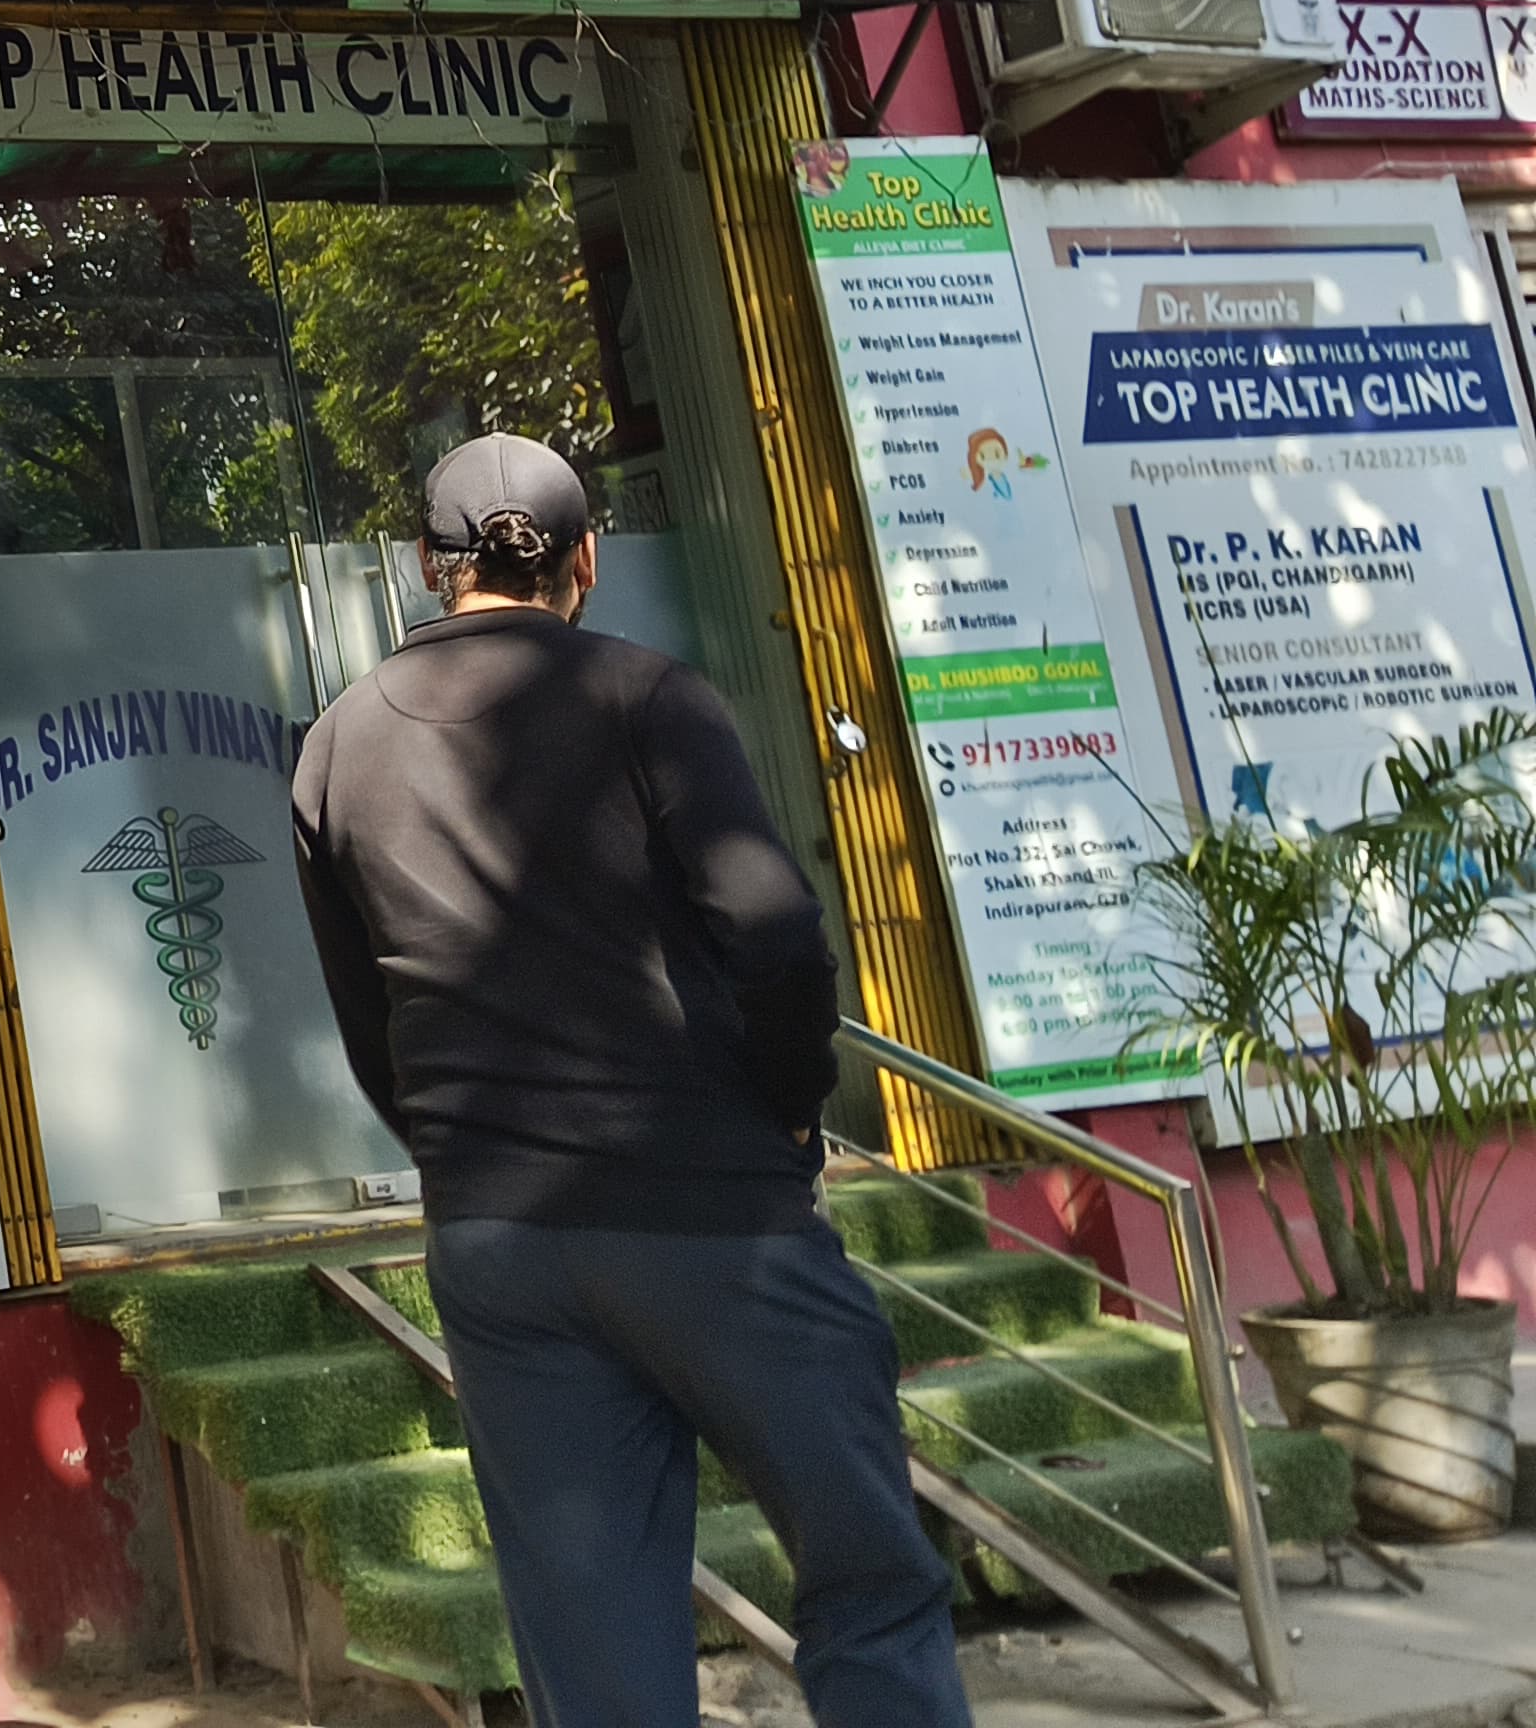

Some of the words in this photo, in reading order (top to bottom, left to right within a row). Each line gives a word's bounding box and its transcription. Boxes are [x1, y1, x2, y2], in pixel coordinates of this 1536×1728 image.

[59, 28, 315, 114] HEALTH
[335, 33, 574, 119] CLINIC
[867, 171, 920, 200] Top
[811, 202, 908, 232] Health
[913, 199, 993, 228] Clinic
[1156, 292, 1195, 325] Dr.
[1204, 291, 1301, 323] Karan's
[1117, 379, 1199, 425] TOP
[1208, 372, 1355, 422] HEALTH
[1361, 369, 1489, 418] CLINIC
[37, 689, 168, 785] SANJAY
